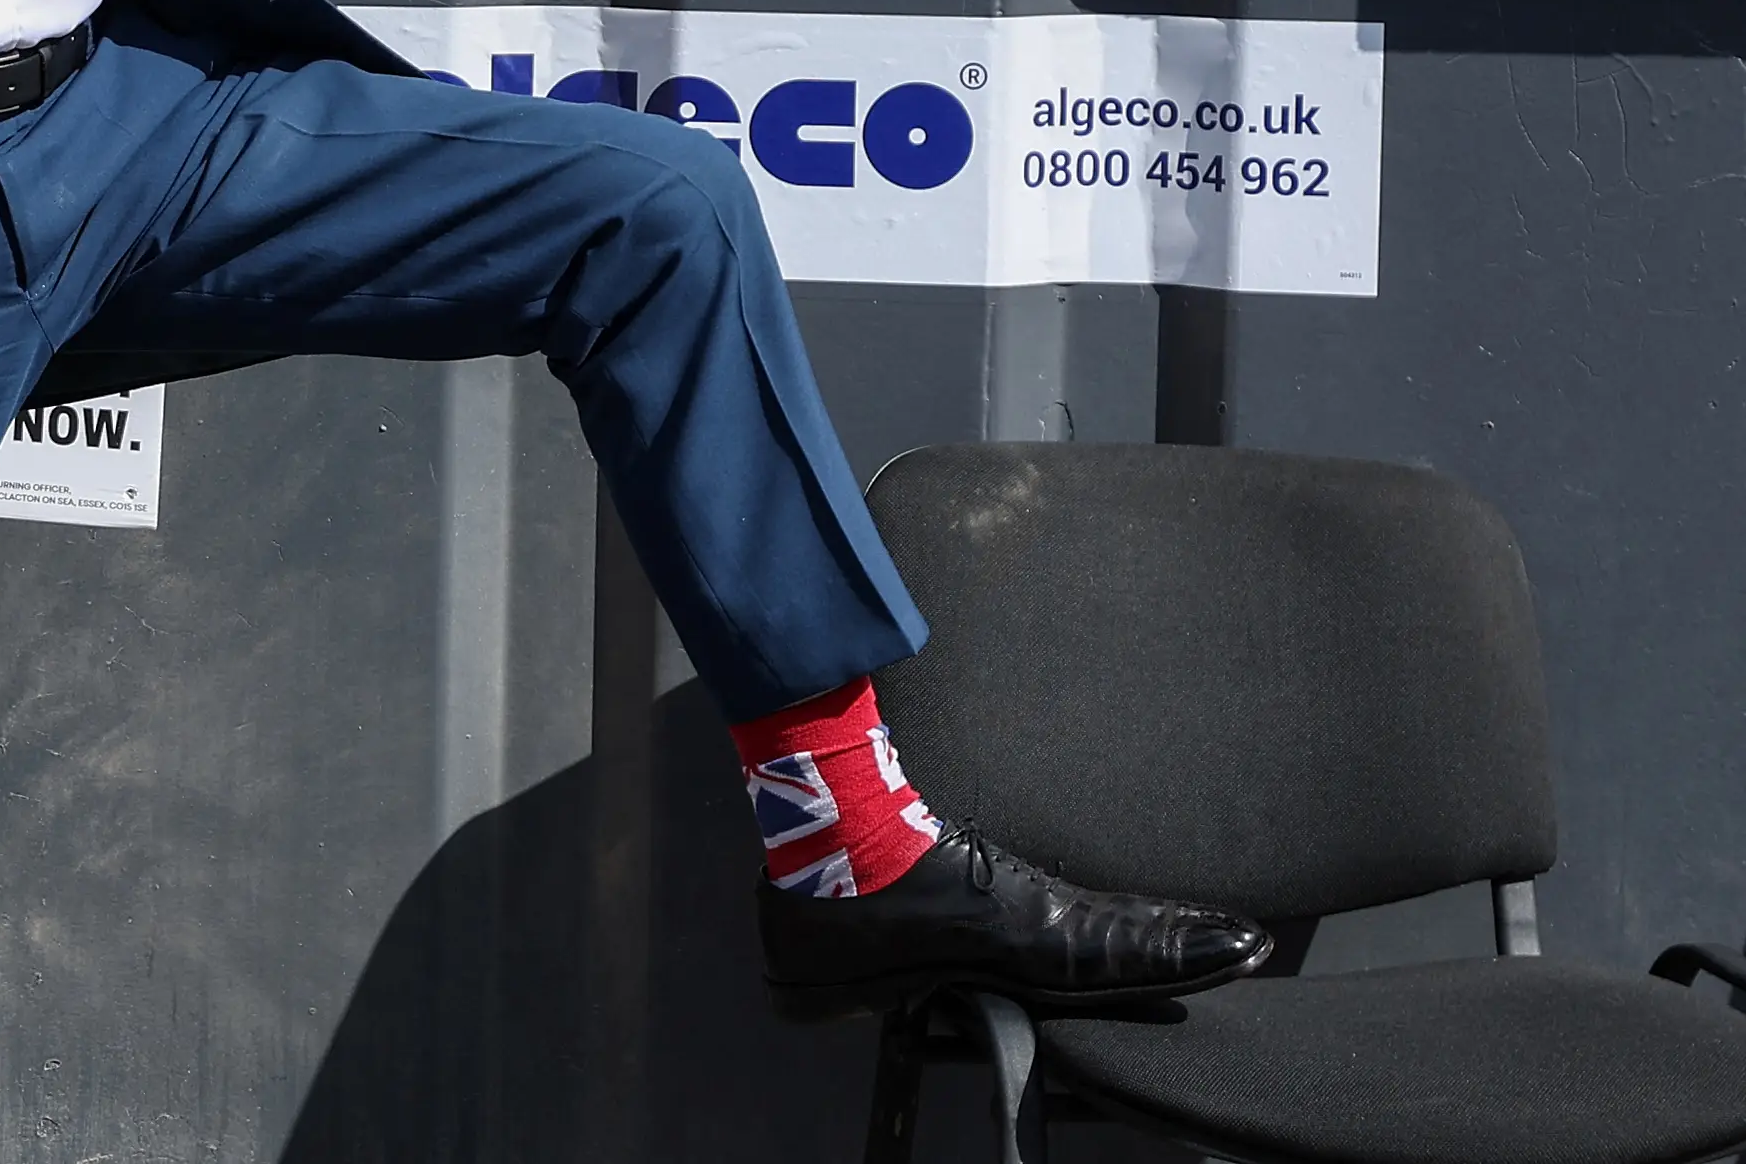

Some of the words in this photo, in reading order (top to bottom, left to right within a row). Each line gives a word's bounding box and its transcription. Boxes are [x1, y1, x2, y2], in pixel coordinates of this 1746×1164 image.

[422, 53, 974, 190] eco
[1033, 87, 1321, 136] algeco.co.uk
[1023, 149, 1130, 188] 0800
[1146, 151, 1226, 193] 454
[1241, 157, 1330, 197] 962
[13, 405, 141, 451] NOW.
[34, 484, 71, 495] OFFICER,
[43, 496, 55, 504] ON
[58, 497, 76, 507] SEA,
[79, 500, 107, 509] ESSEX,
[110, 502, 131, 511] CO15
